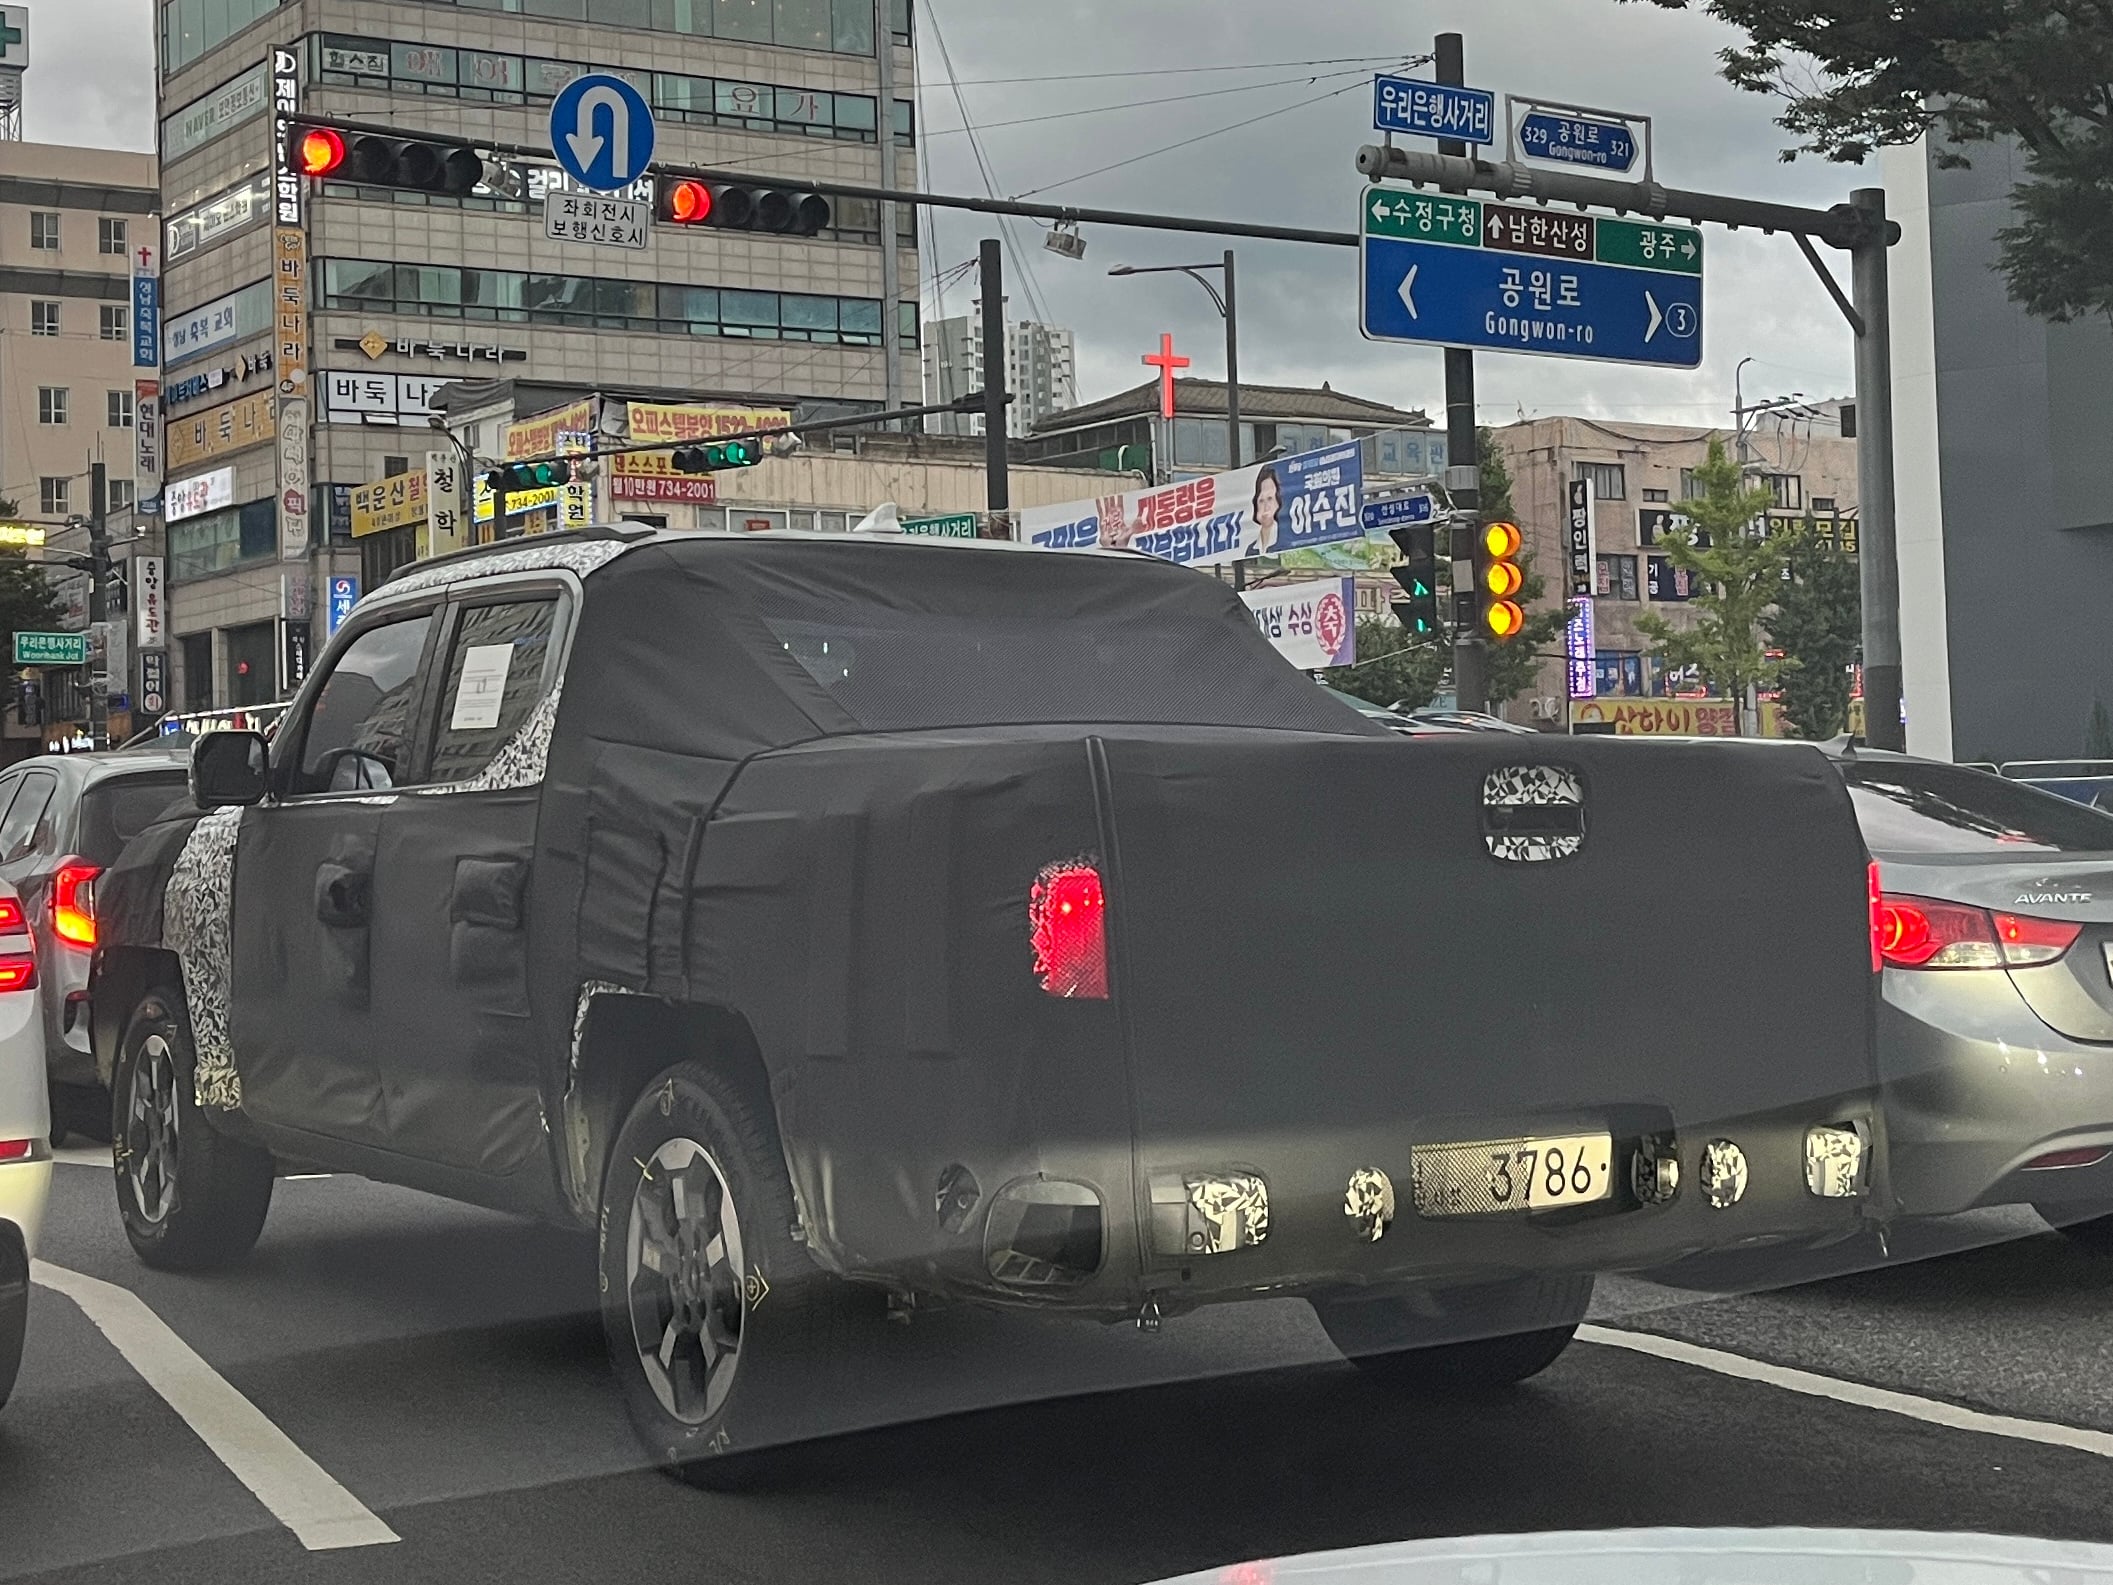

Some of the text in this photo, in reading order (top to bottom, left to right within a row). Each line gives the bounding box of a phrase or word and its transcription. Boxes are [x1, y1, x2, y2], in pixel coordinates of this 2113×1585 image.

[1381, 85, 1489, 136] 우리은행사거리
[1524, 126, 1548, 145] 329
[1557, 120, 1601, 146] 공원로
[1610, 138, 1630, 158] 321
[1548, 141, 1608, 165] Gongwon-ro
[562, 197, 636, 225] 좌회전시
[1392, 200, 1476, 238] 수정구청
[550, 219, 644, 248] 보행신호시
[1508, 214, 1588, 252] 남한산성
[1638, 230, 1677, 260] 광주
[1498, 267, 1583, 311] 공원로
[281, 258, 300, 362] 바둑나라
[1675, 308, 1687, 331] 3
[1485, 311, 1594, 345] Gongwon-ro
[396, 337, 505, 366] 바둑나라
[631, 408, 714, 439] 오피스텔분양
[355, 480, 406, 515] 백운산
[434, 467, 458, 537] 철학
[511, 489, 556, 510] 734-2001
[567, 484, 586, 522] 학원
[658, 480, 715, 499] 734-2001
[1289, 483, 1357, 535] 이수진
[1288, 601, 1313, 637] 수상
[20, 635, 82, 650] 우리은행사거리
[2013, 892, 2094, 904] AVANTE
[1490, 1145, 1592, 1203] 3786
